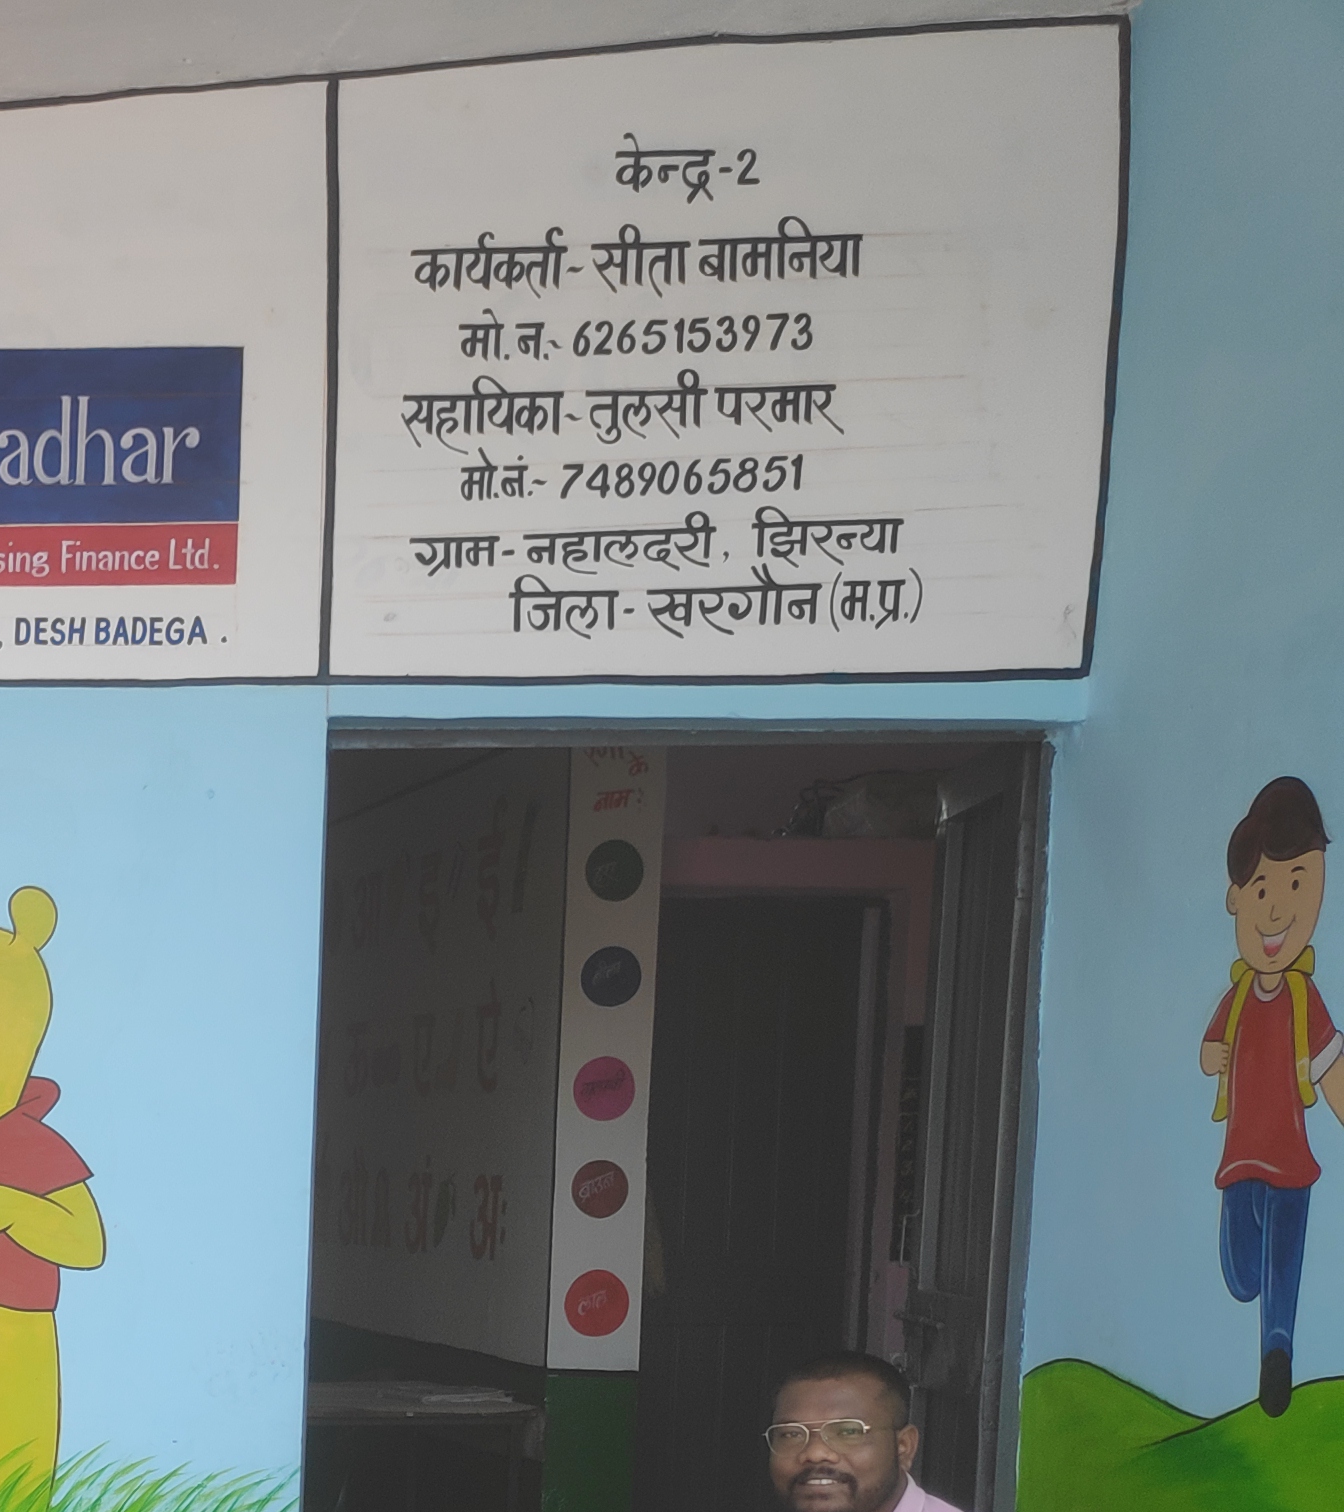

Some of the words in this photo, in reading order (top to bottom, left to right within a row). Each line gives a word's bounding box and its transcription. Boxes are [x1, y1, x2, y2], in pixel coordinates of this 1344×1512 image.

[698, 215, 864, 280] बामनिया
[572, 312, 814, 357] 6265153973
[713, 383, 845, 435] परमार
[560, 453, 804, 500] 7489065851
[61, 537, 161, 574] Finance
[169, 537, 220, 571] Ltd.
[14, 616, 87, 647] DESH
